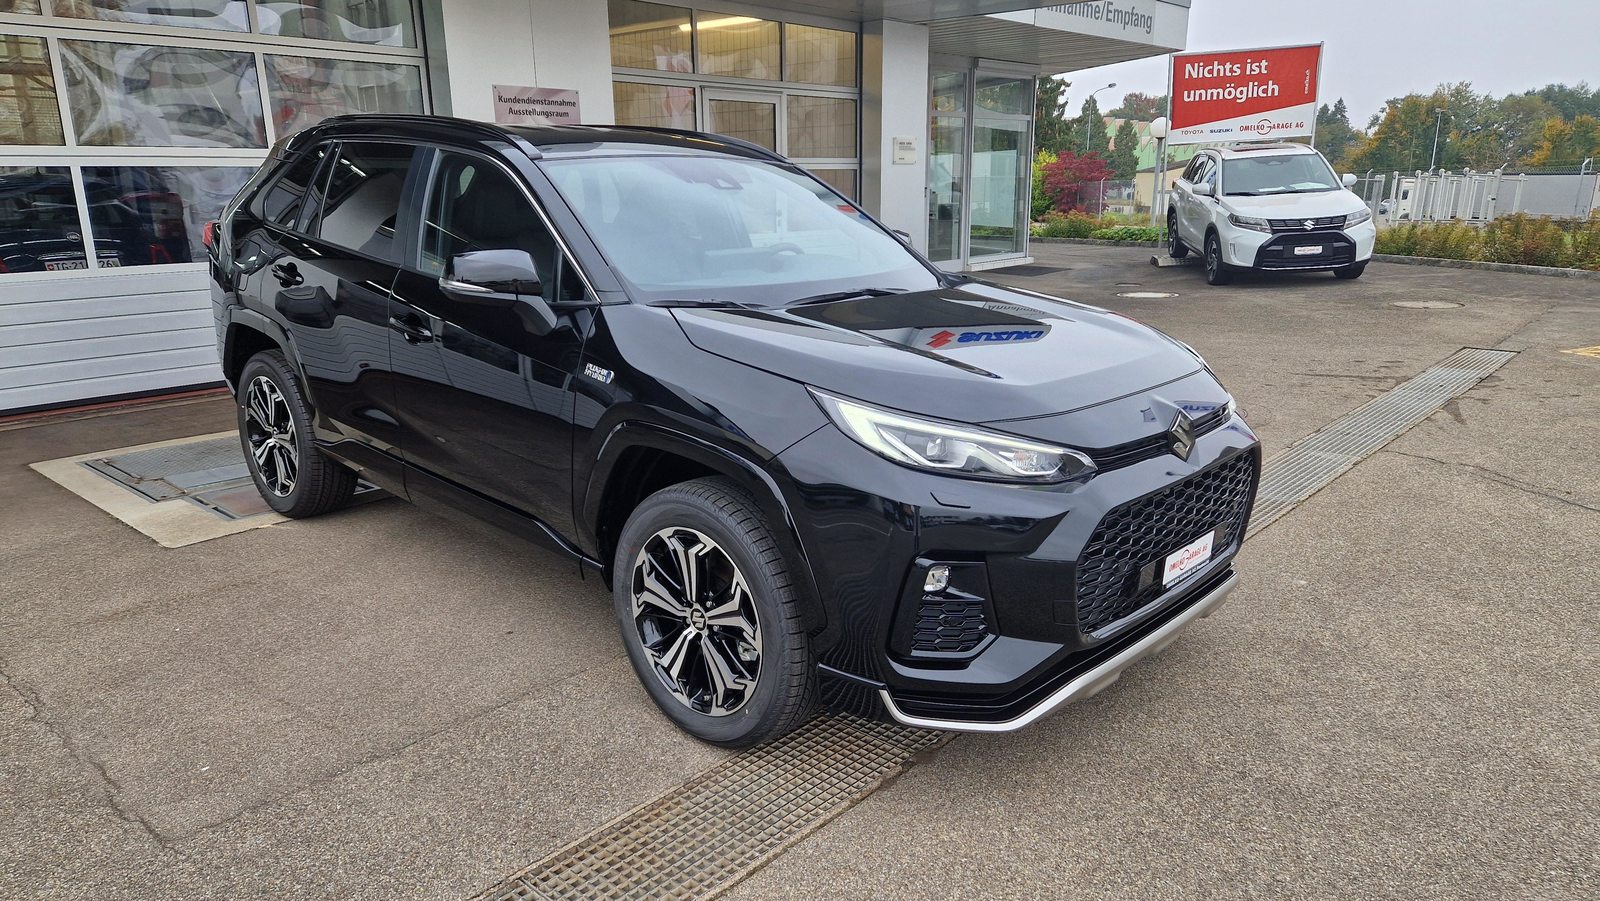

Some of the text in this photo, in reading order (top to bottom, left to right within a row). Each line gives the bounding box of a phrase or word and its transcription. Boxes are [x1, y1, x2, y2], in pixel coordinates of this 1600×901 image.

[1184, 58, 1268, 79] Nichts ist
[1183, 80, 1279, 103] unmöglich
[497, 95, 577, 107] Kundendienstannahme
[508, 107, 569, 118] Ausstellungsraum
[1239, 124, 1264, 132] OMELKO
